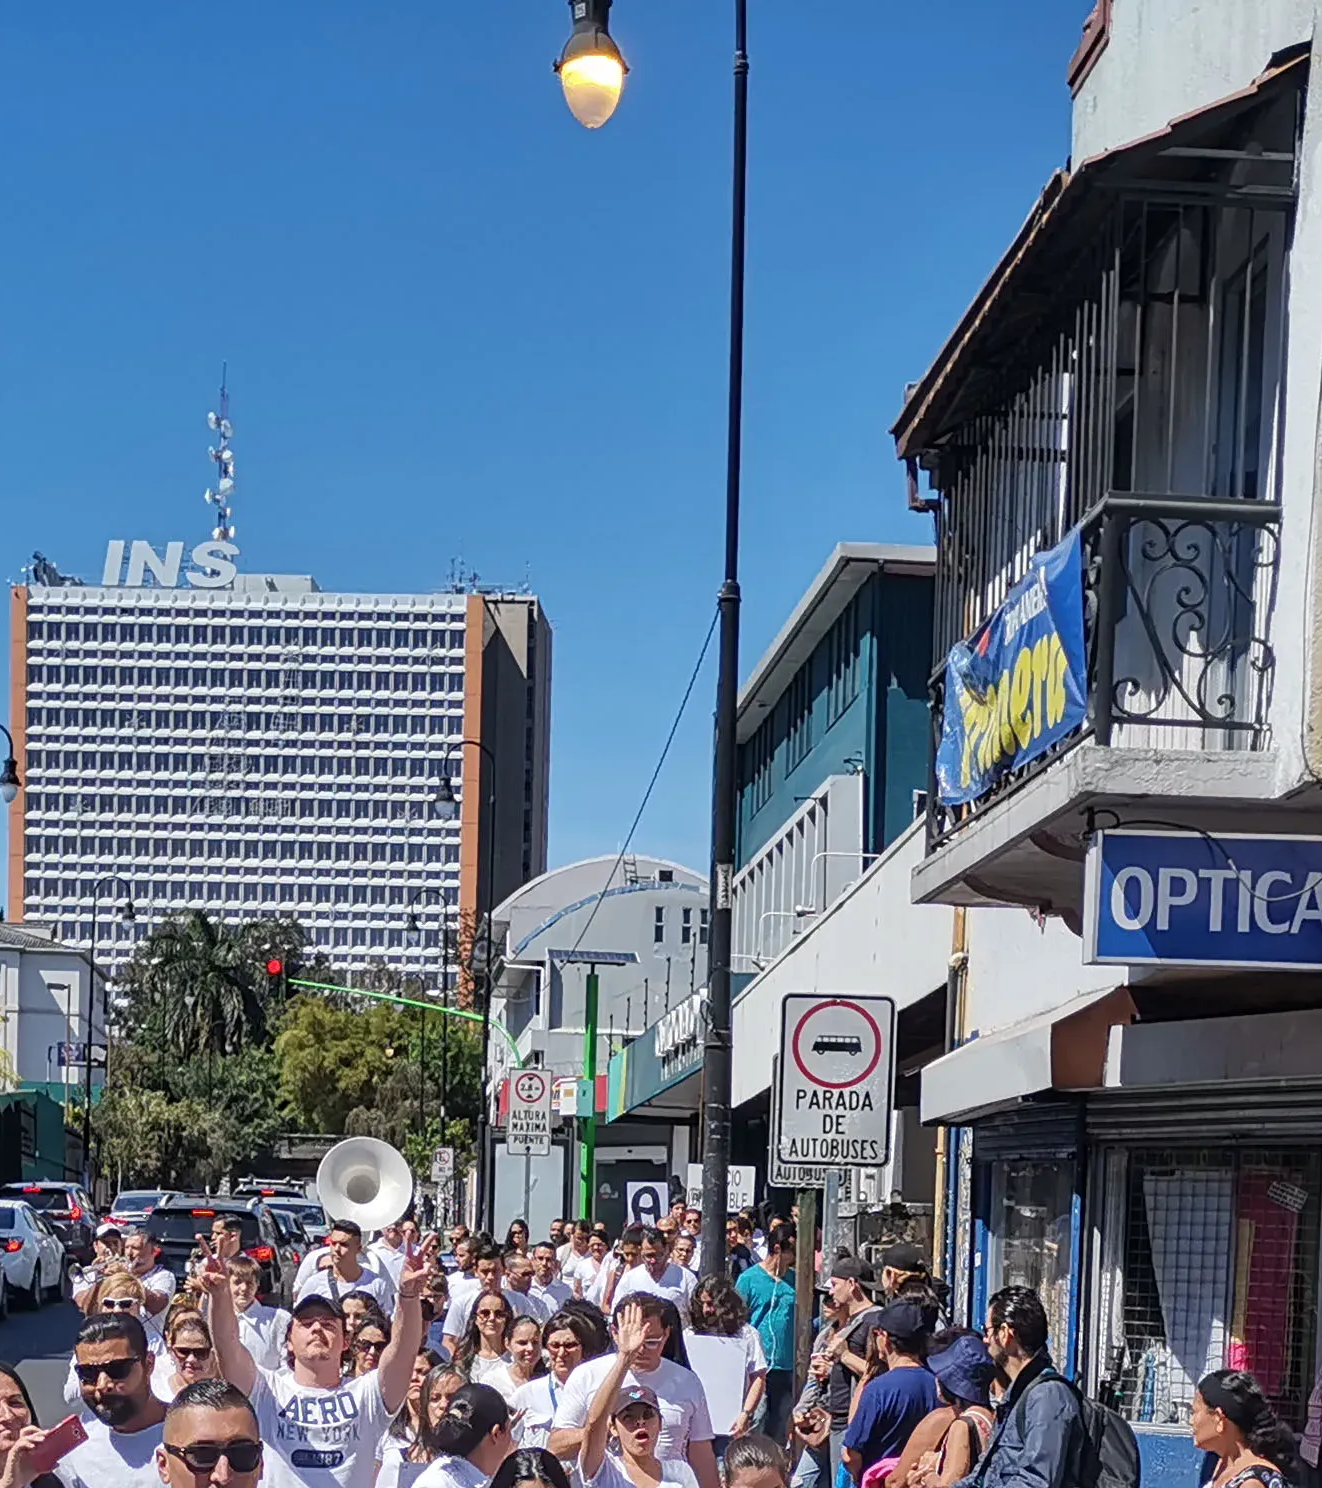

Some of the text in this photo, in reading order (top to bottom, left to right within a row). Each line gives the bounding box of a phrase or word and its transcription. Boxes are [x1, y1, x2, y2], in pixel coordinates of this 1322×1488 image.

[102, 540, 240, 588] INS
[796, 1089, 874, 1111] PARADA
[512, 1110, 546, 1121] ALTURA
[822, 1114, 846, 1135] DE
[512, 1122, 547, 1132] MAXIMA
[513, 1135, 544, 1144] PUENTE
[789, 1138, 879, 1160] AUTOBUSES
[278, 1391, 359, 1425] AERO
[277, 1421, 361, 1442] NEW YORK
